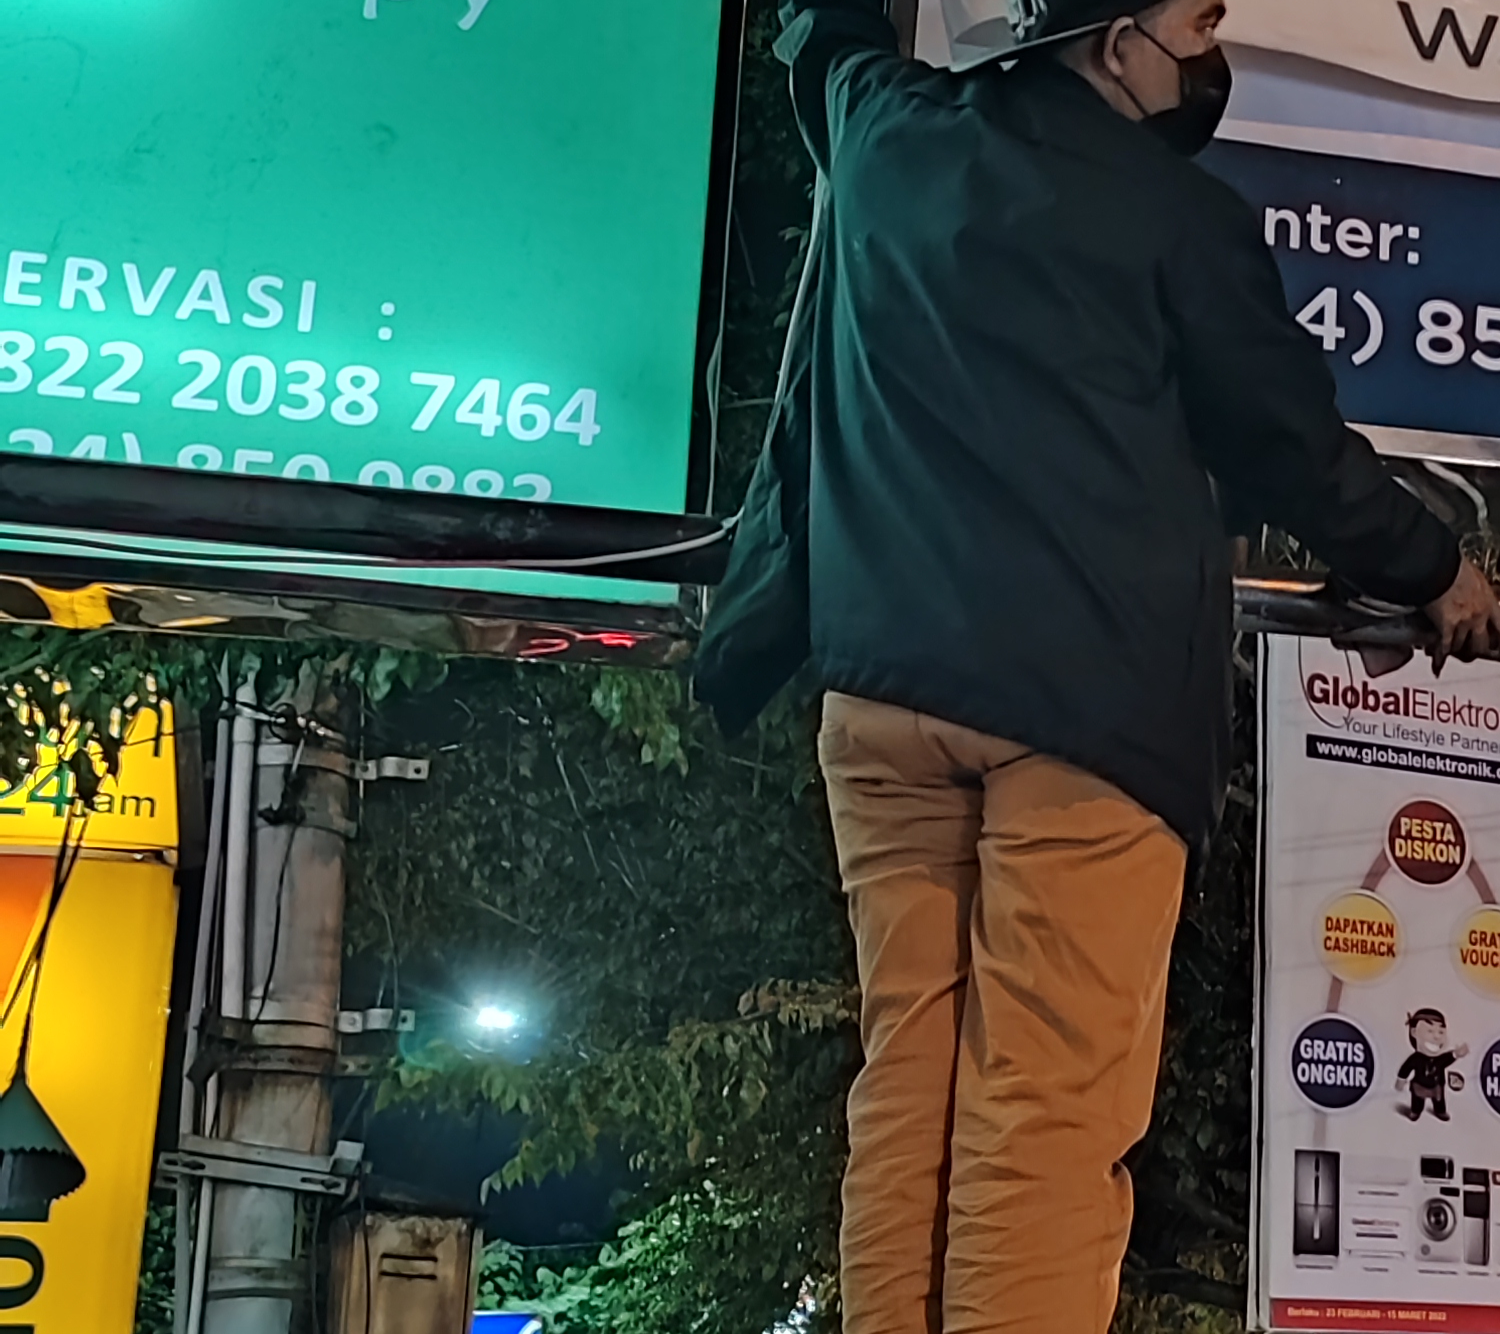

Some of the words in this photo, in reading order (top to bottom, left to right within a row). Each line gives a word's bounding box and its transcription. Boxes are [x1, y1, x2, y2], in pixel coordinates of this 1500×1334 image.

[171, 349, 381, 427] 2038
[408, 371, 601, 447] 7464
[1342, 716, 1378, 737] Your
[1382, 722, 1446, 748] Lifestyle
[1400, 817, 1456, 843] PESTA
[1395, 838, 1461, 865] DISKON
[1325, 916, 1395, 939] DAPATKAN
[1323, 936, 1396, 958] CASHBACK
[1300, 1039, 1365, 1064] GRATIS
[1297, 1063, 1368, 1089] ONGKIR
